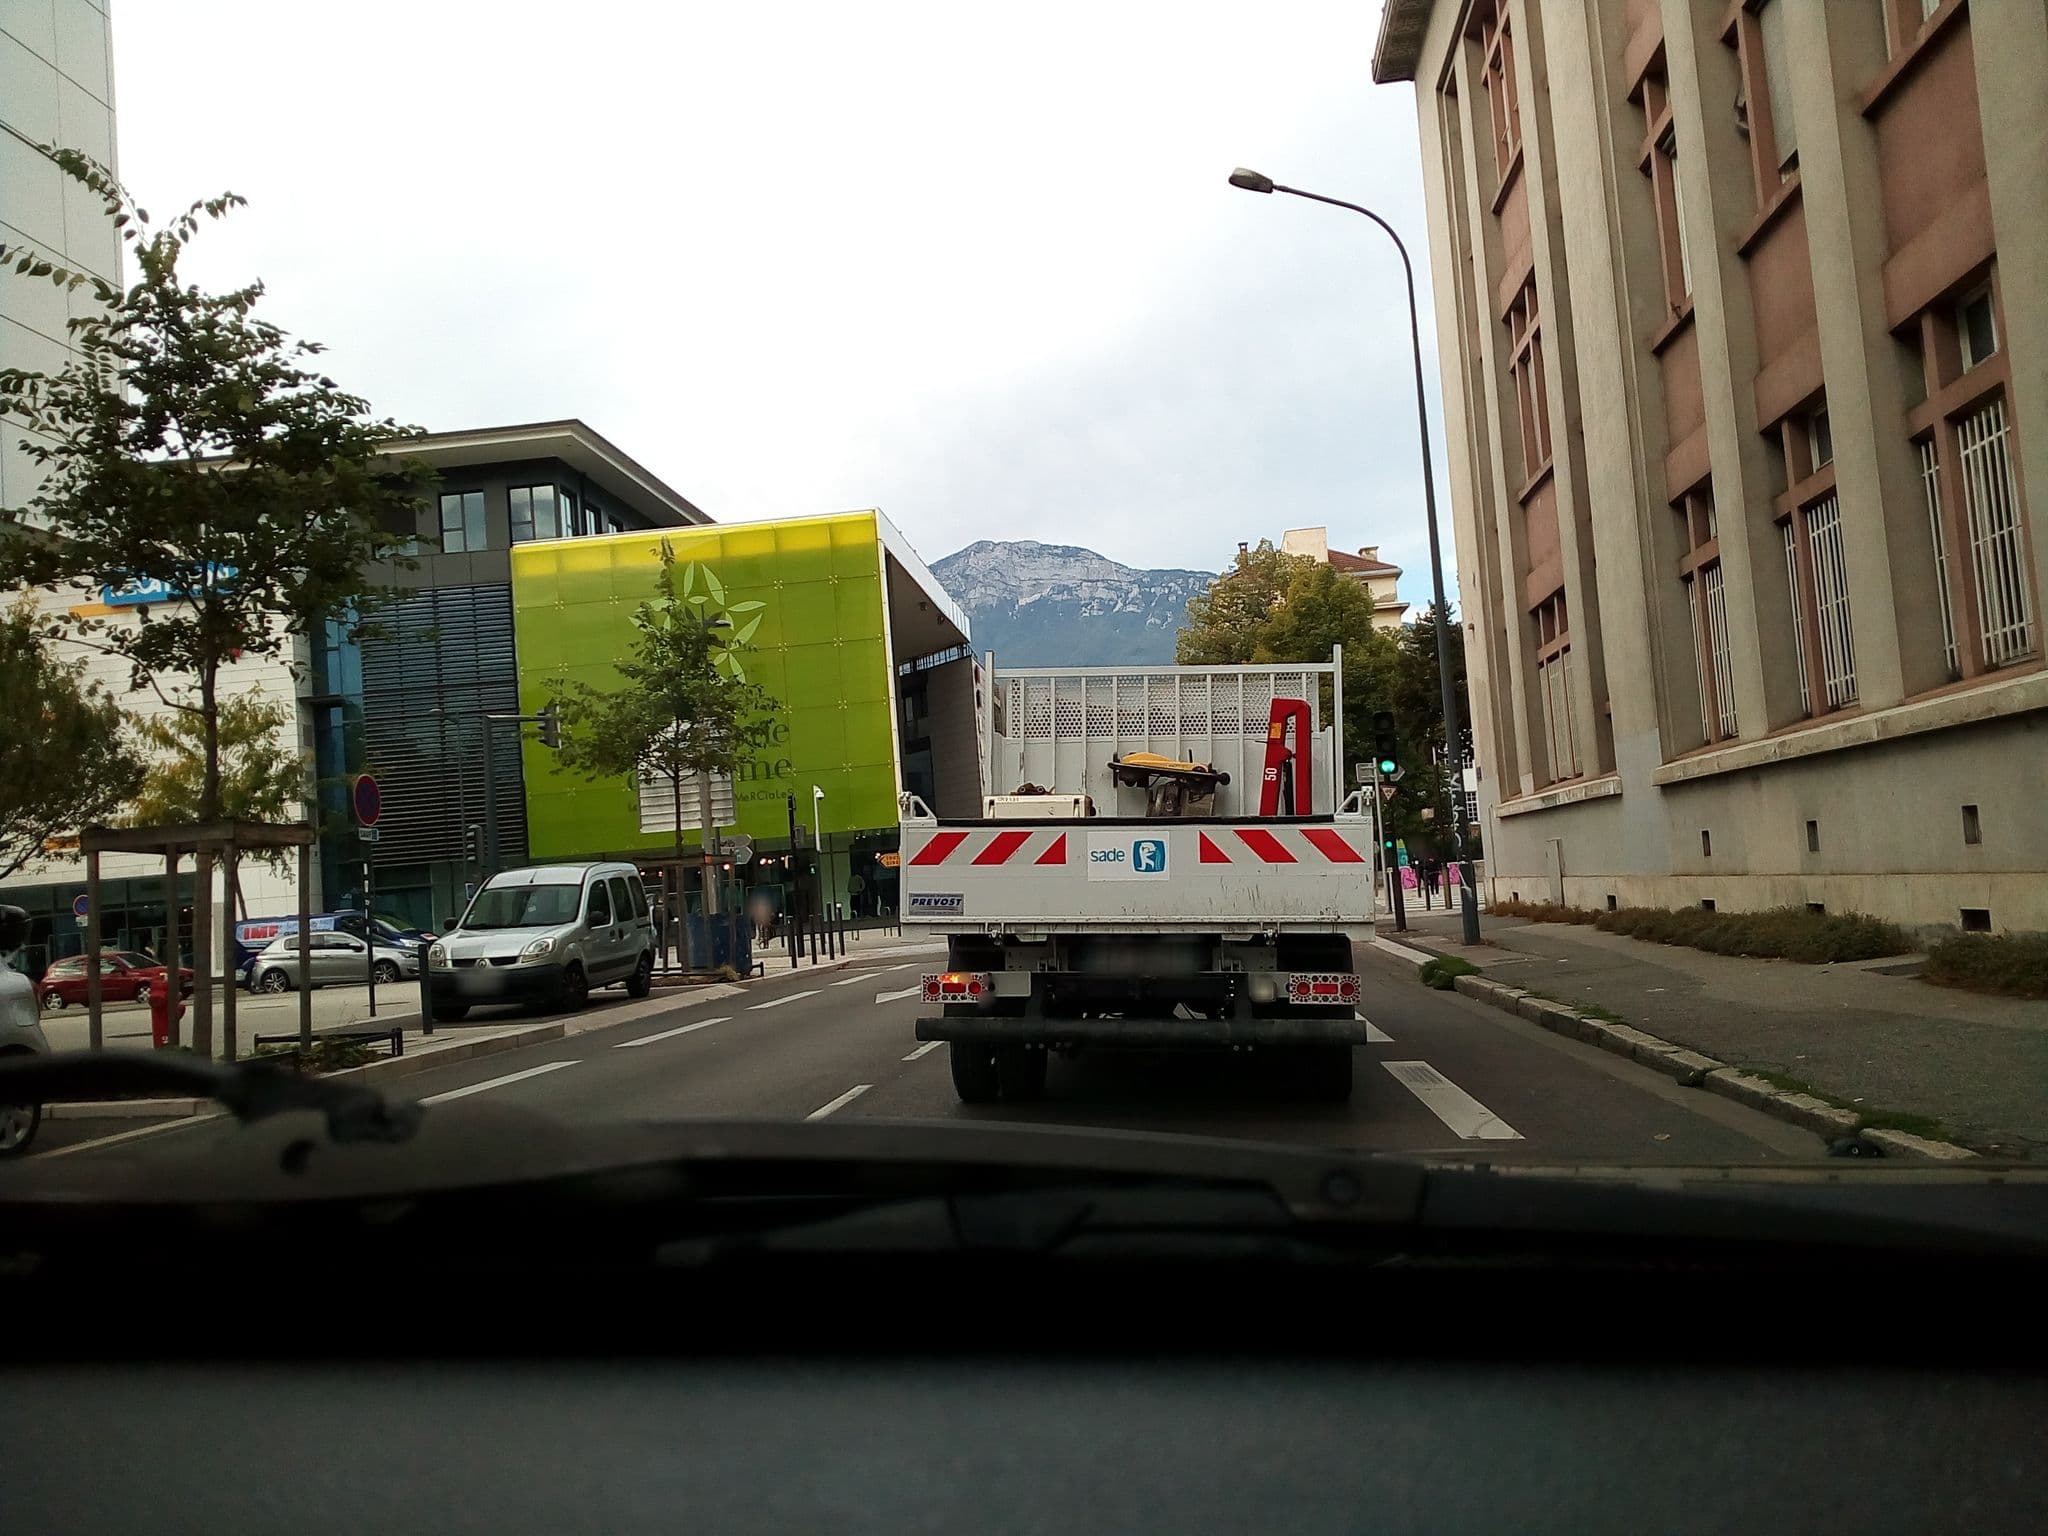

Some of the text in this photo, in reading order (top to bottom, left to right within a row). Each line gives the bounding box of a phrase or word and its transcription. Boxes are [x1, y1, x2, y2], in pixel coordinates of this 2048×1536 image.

[1264, 767, 1277, 781] 50
[1090, 847, 1126, 862] sade
[911, 898, 962, 906] PREVOST
